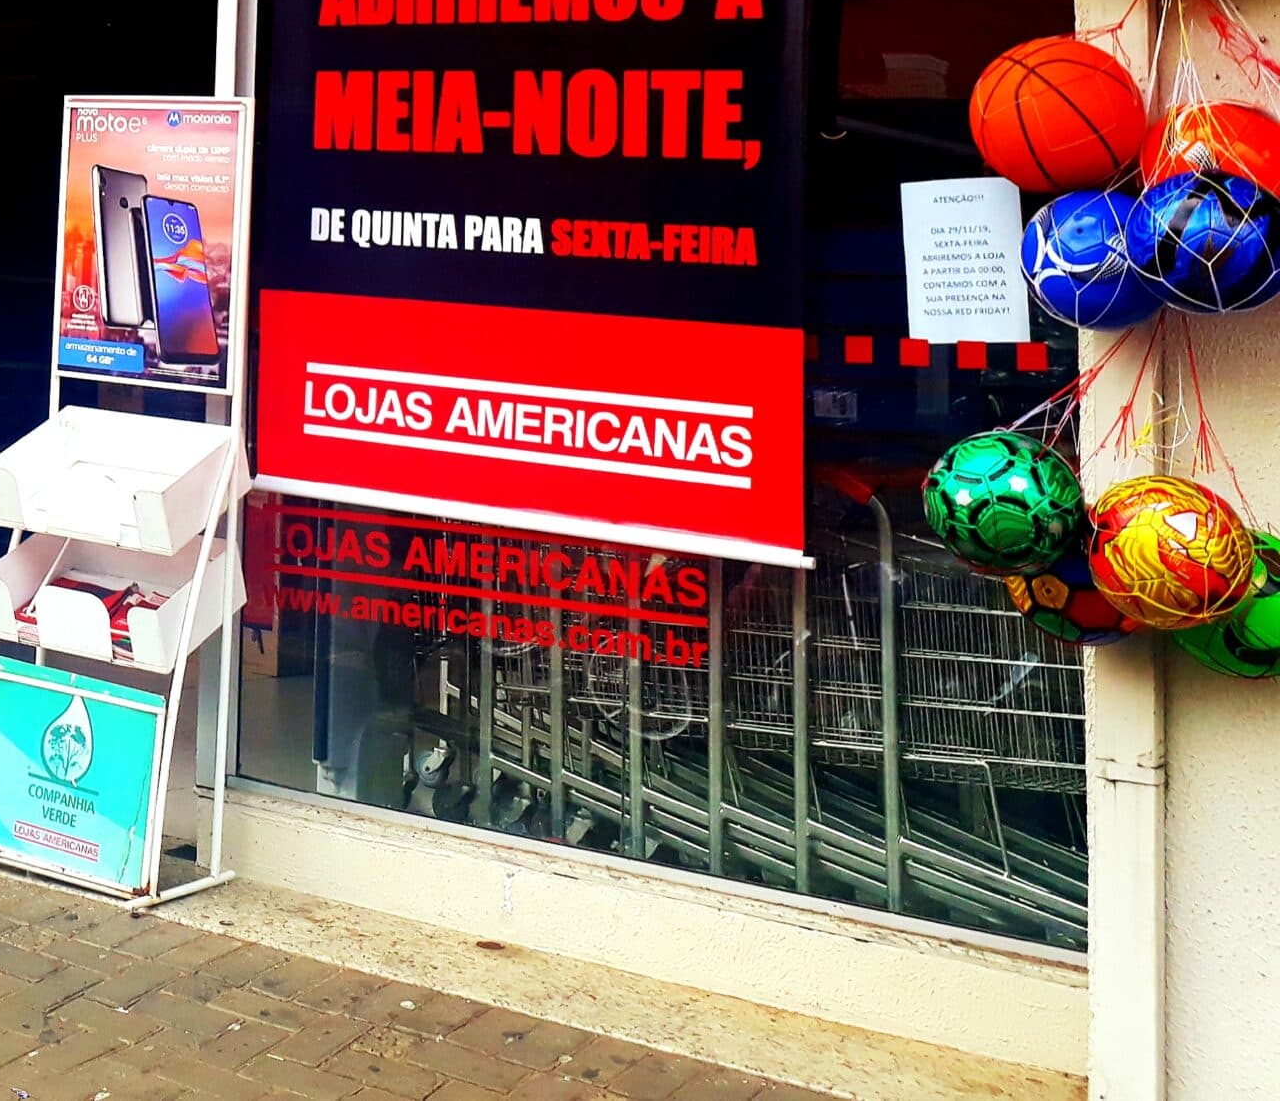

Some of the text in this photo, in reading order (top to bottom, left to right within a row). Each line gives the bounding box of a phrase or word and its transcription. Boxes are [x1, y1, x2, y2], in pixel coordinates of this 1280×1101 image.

[182, 112, 232, 125] motorola
[313, 68, 762, 170] MEIA-NOITE,
[75, 132, 98, 143] PLUS
[933, 194, 984, 205] ATENÇÃO!!!
[310, 206, 759, 267] DE QUINTA PARA SEXTA-FEIRA
[930, 227, 945, 235] DIA
[934, 239, 989, 248] SEXTA-FEIRA
[922, 251, 1006, 262] ABRIREMOS A LOJA
[923, 267, 928, 275] A
[931, 266, 961, 275] PARTIR
[963, 266, 976, 274] DA
[923, 279, 1007, 290] CONTAMOS COM A
[925, 294, 943, 303] SUA
[945, 293, 990, 302] PRESENÇA
[923, 306, 1010, 316] NOSSA RED FRIDAY!
[65, 342, 137, 356] armazenamento de
[303, 380, 433, 432] LOJAS
[444, 396, 754, 469] AMERICANAS
[272, 521, 708, 610] OJAS AMERICANAS
[27, 783, 95, 815] COMPANHIA
[42, 804, 77, 828] VERDE
[14, 823, 100, 858] LOJAS AMERICANAS
